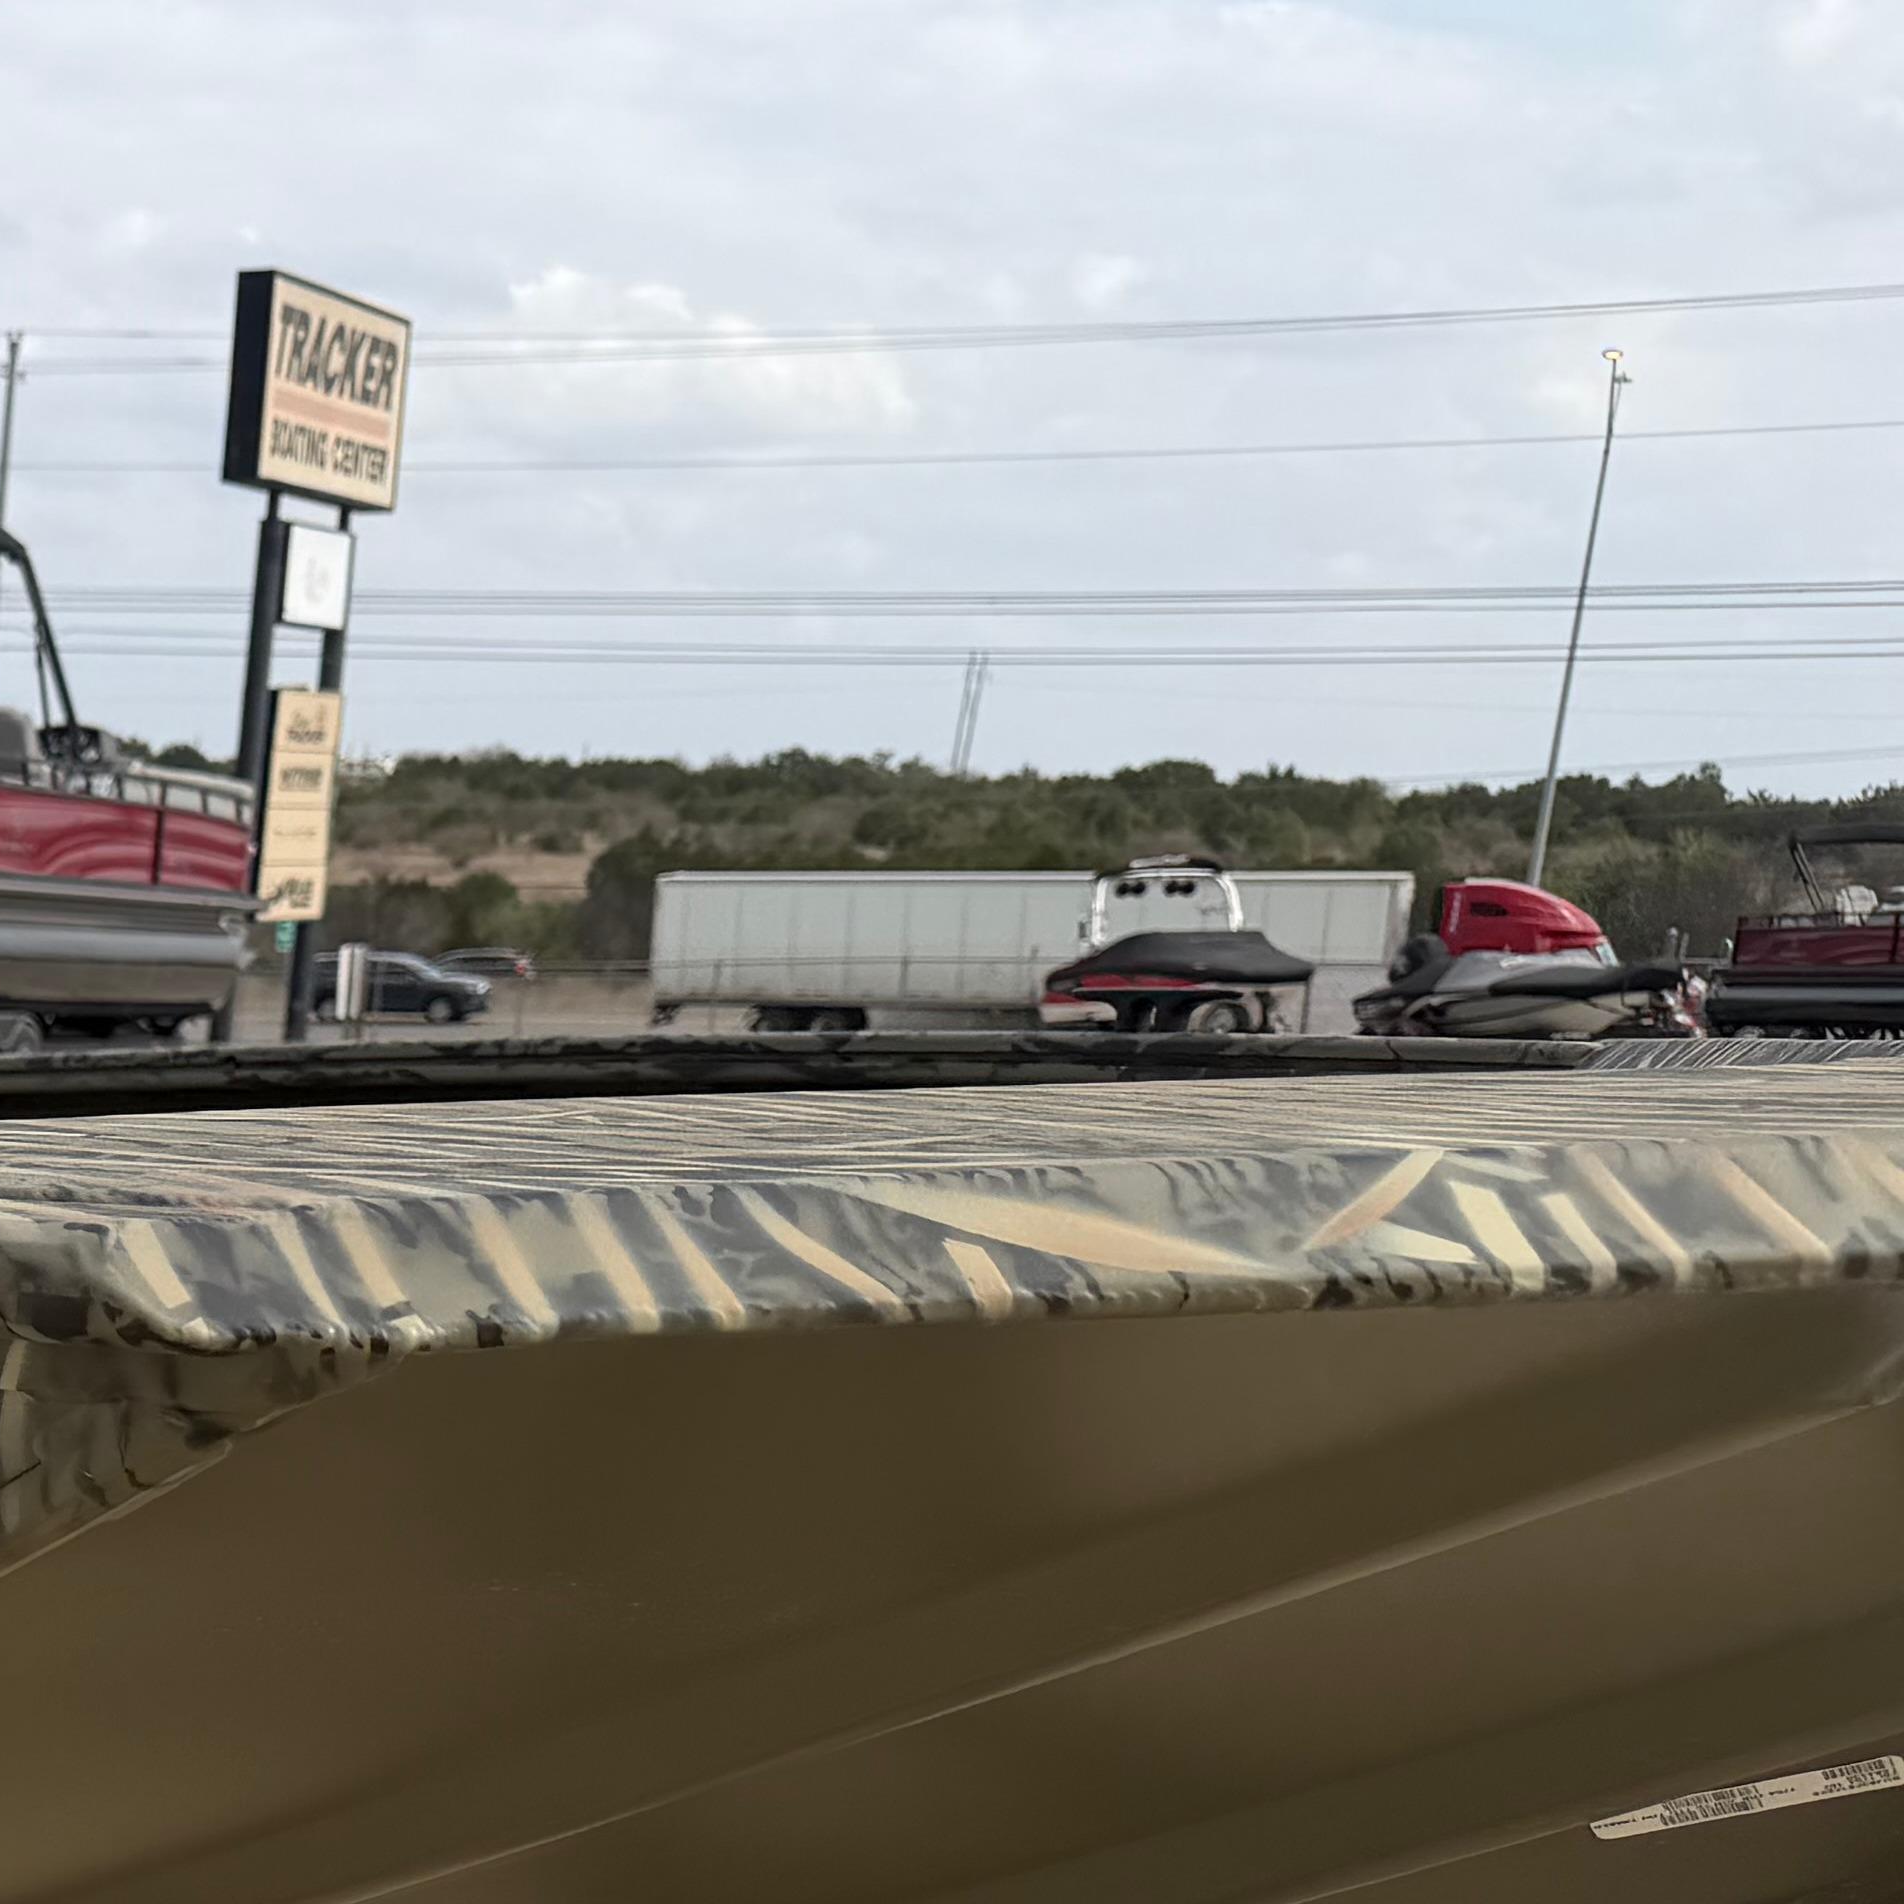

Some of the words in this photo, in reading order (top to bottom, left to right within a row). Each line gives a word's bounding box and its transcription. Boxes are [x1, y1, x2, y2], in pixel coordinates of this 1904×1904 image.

[274, 304, 399, 411] TRACKER
[270, 418, 329, 467] BOATING
[332, 434, 387, 484] CENTER
